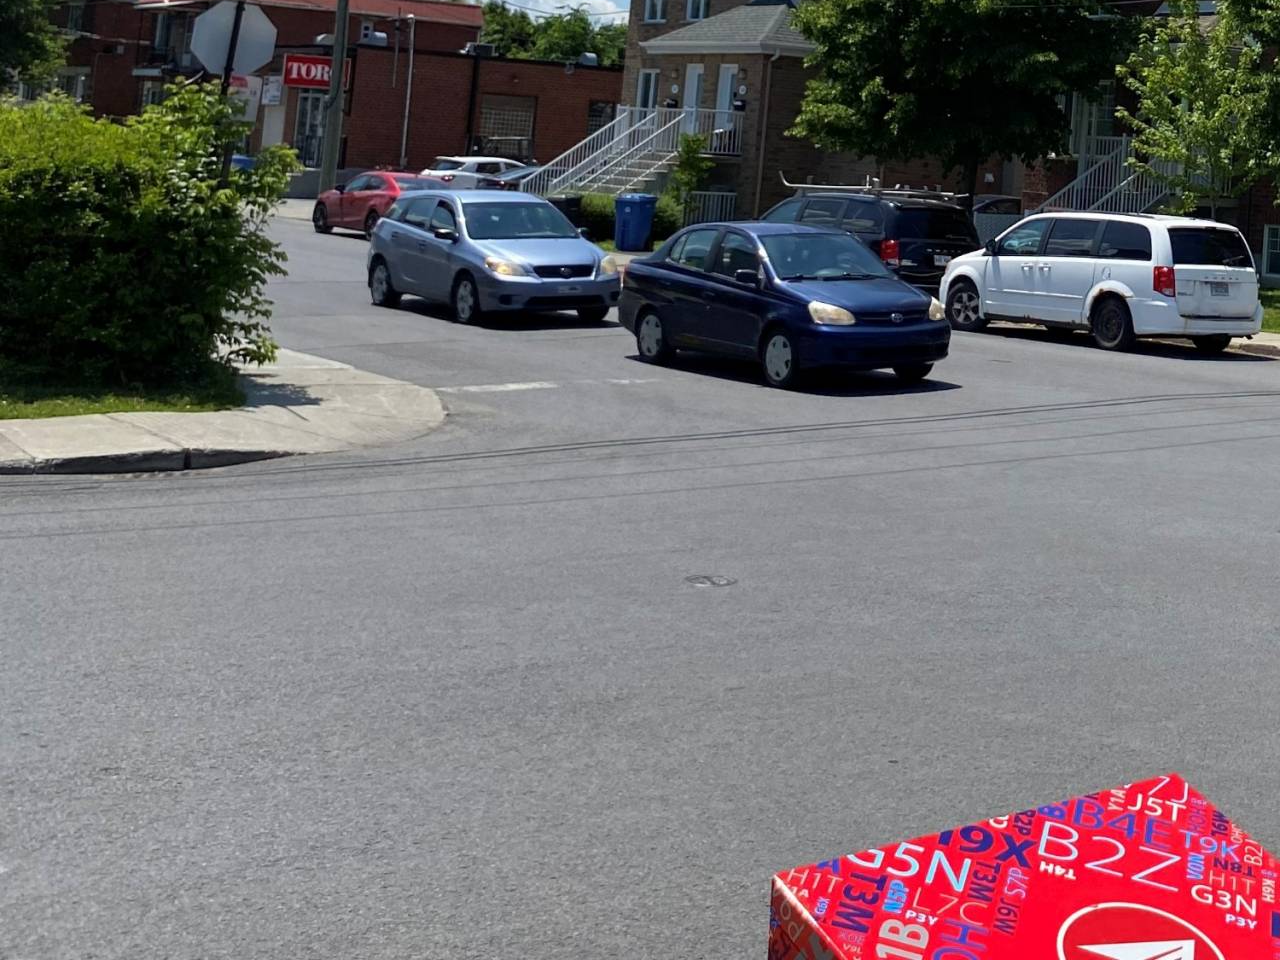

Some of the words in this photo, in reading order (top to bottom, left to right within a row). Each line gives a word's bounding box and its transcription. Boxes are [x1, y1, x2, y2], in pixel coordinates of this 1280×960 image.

[288, 61, 333, 81] TOR
[1127, 793, 1187, 822] J5T
[1038, 820, 1181, 893] B2Z
[1178, 828, 1242, 865] T9K
[1039, 861, 1076, 880] T4H
[831, 872, 888, 934] T3M
[1190, 884, 1258, 917] G3N
[905, 909, 939, 926] P3Y
[1225, 913, 1257, 930] P3Y
